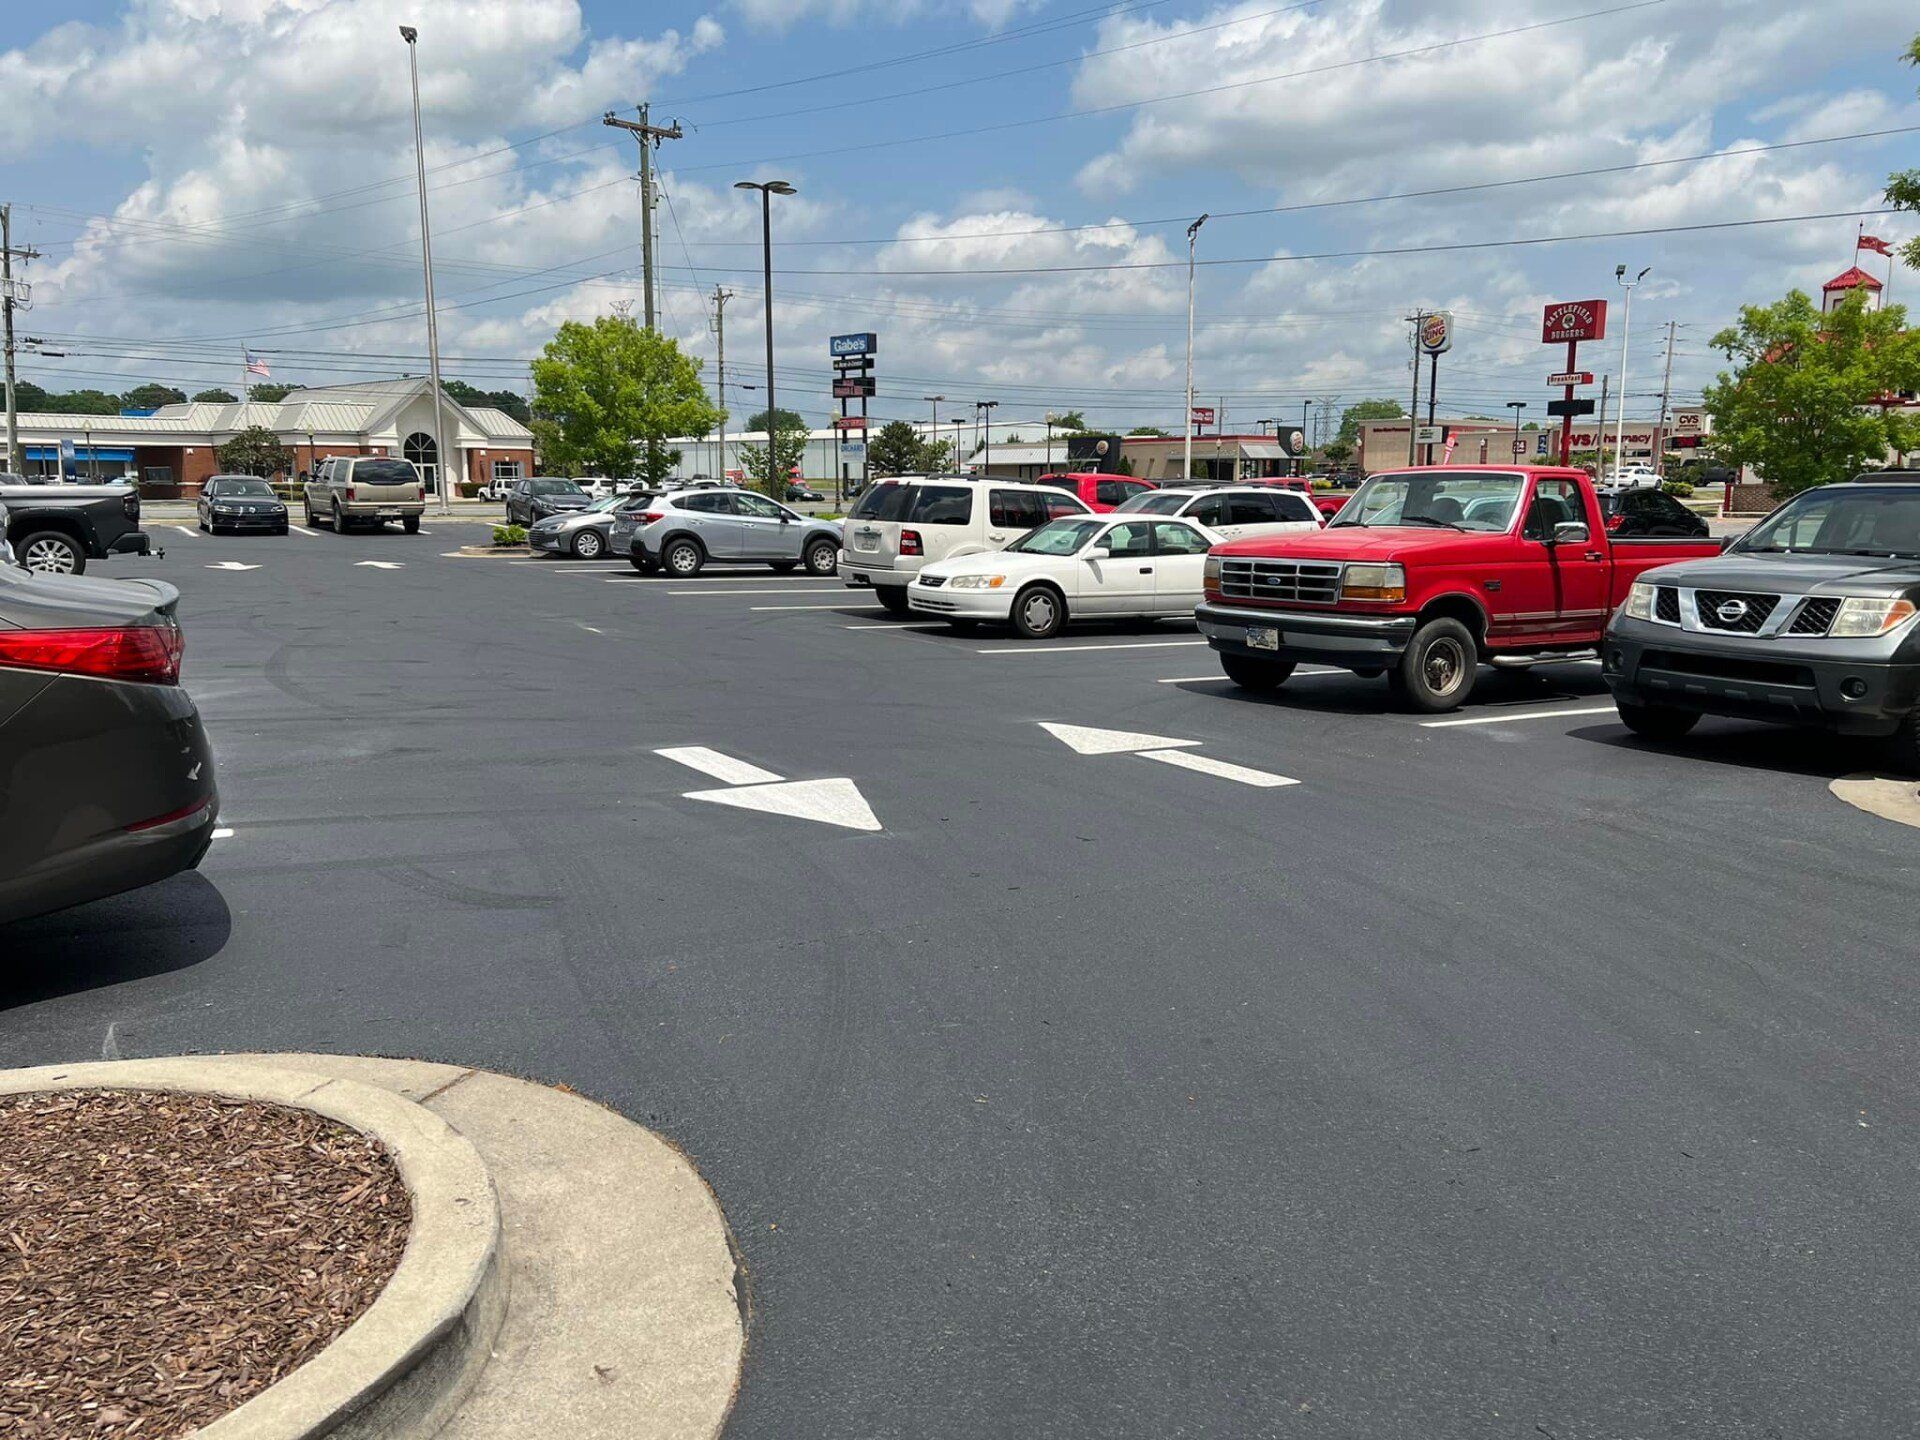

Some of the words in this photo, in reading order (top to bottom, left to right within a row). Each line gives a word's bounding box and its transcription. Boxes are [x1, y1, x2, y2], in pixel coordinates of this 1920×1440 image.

[1545, 304, 1594, 328] BATTLEFIELD
[1424, 325, 1446, 343] KING
[1551, 328, 1585, 340] BURGERS
[834, 339, 866, 352] Gabe's
[1549, 375, 1581, 383] Breakfast
[1679, 415, 1699, 424] CVS
